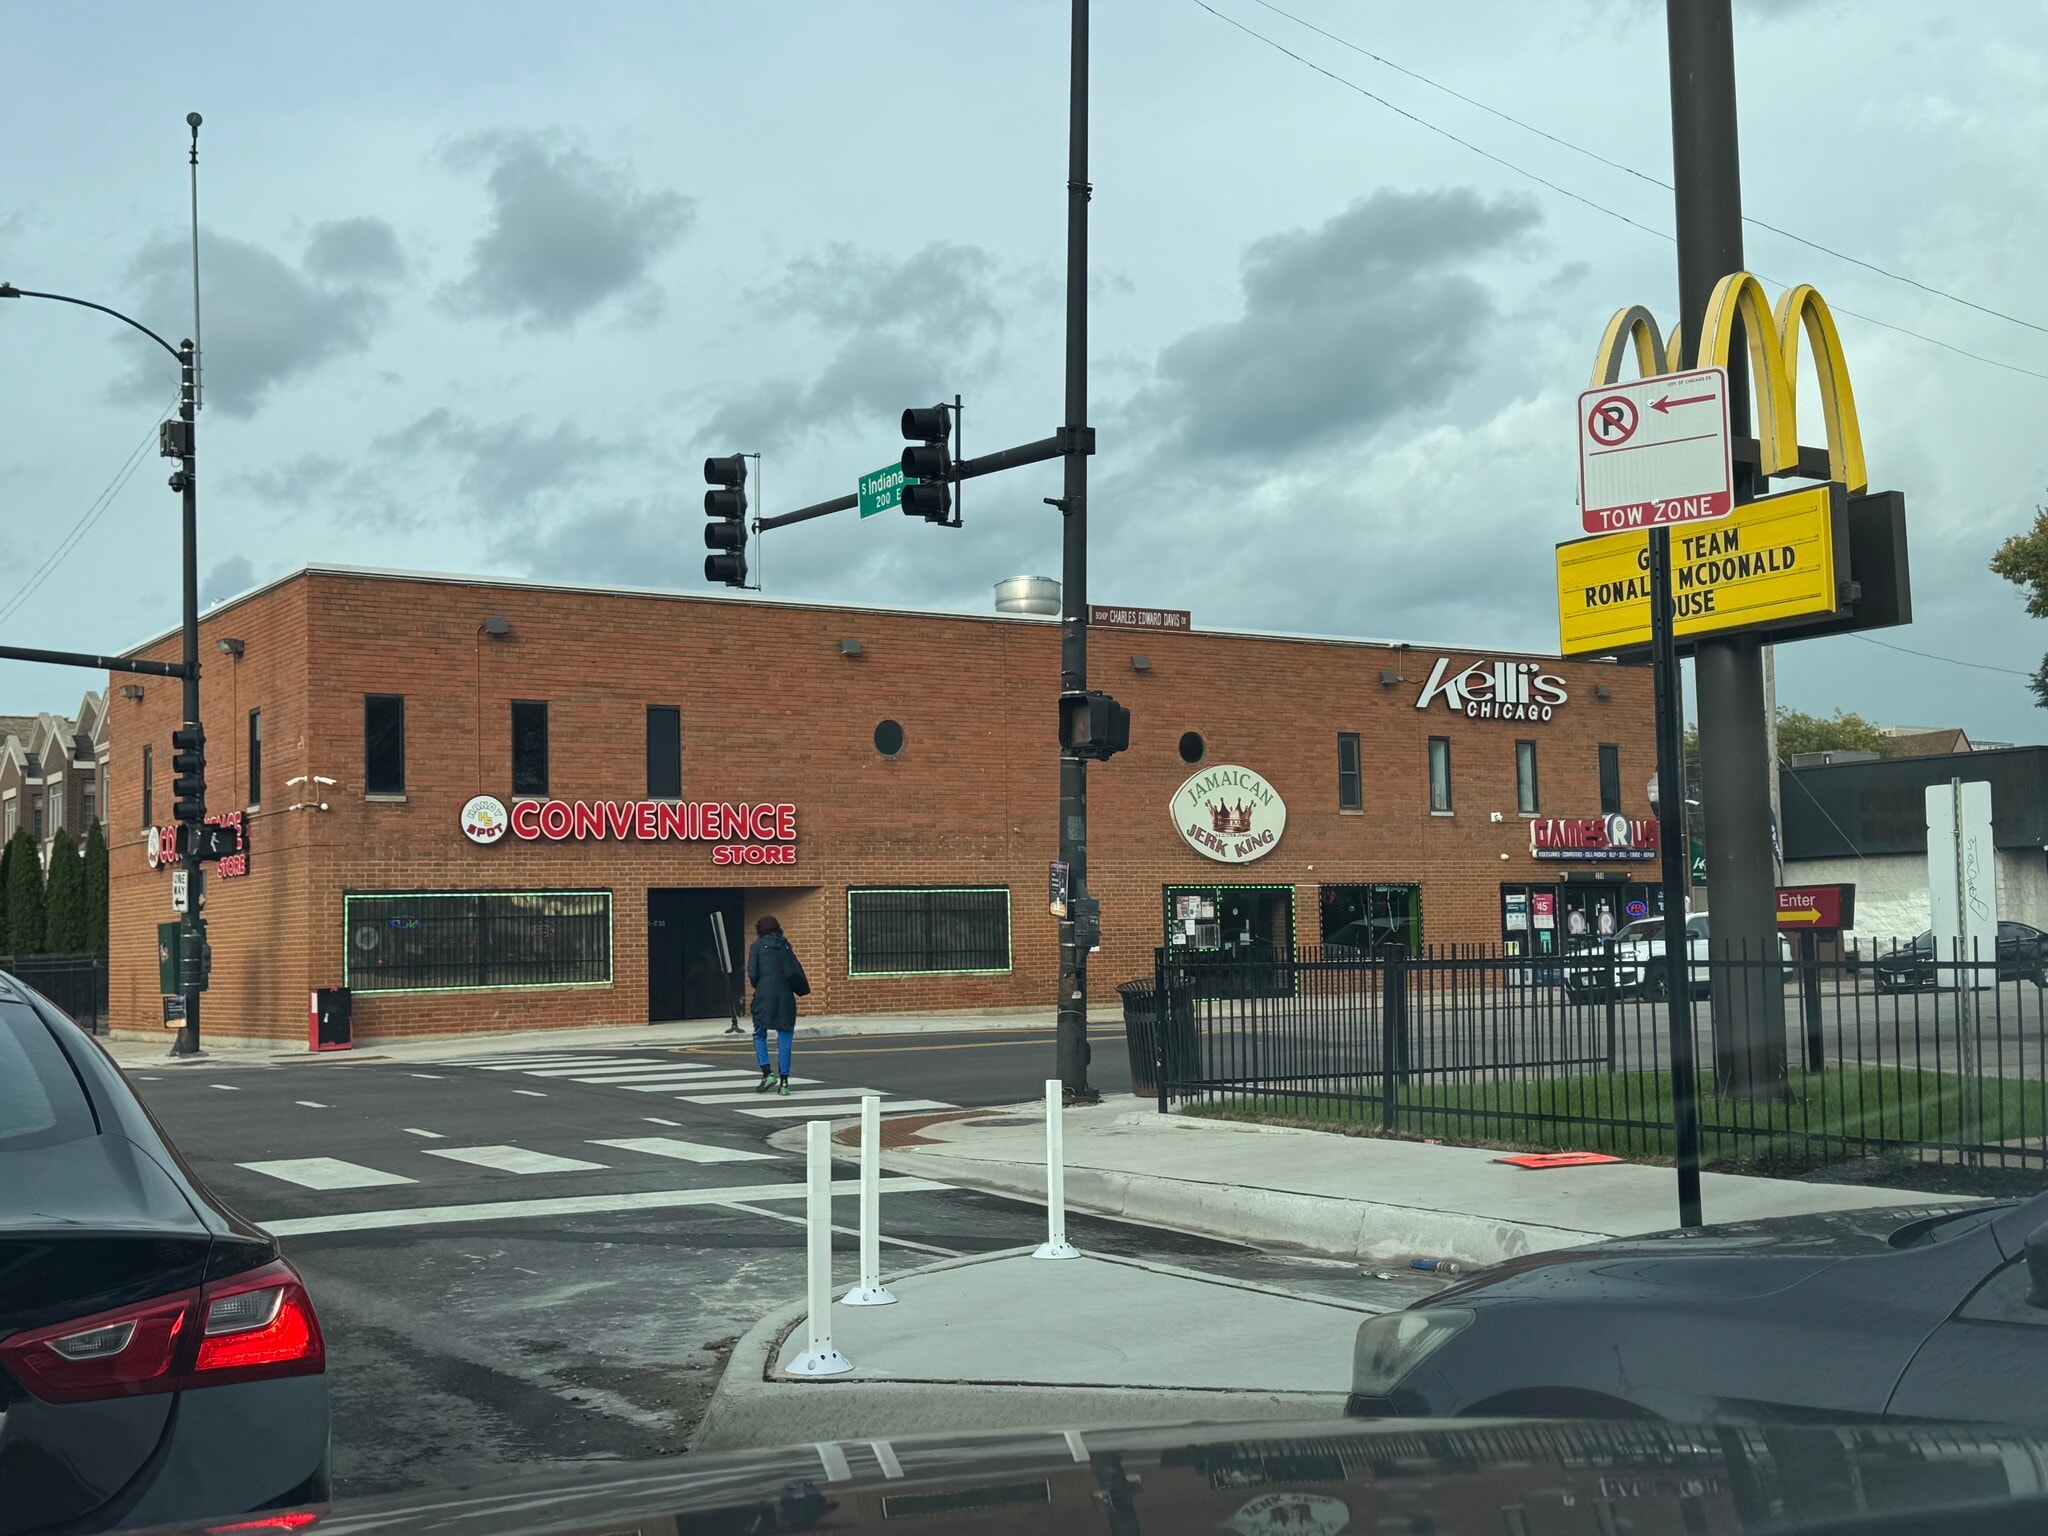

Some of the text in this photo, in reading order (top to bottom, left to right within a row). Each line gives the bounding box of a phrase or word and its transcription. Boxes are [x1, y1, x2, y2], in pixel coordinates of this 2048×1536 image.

[862, 471, 904, 495] S Indiana
[876, 492, 891, 508] 200
[1600, 496, 1713, 529] TOW ZONE
[1682, 528, 1740, 561] TEAM
[1585, 546, 1796, 608] RONAL MCDONALD
[1109, 609, 1136, 625] CHARLES
[1138, 611, 1162, 626] EDWARD
[1163, 612, 1180, 627] DAVIS
[1415, 657, 1568, 710] Kelli's
[1466, 701, 1552, 721] CHICAGO
[1187, 770, 1274, 808] JAMAICAN
[466, 800, 504, 820] HANDY
[511, 800, 797, 841] CONVENIENCE
[466, 823, 504, 838] SPOT
[1186, 823, 1275, 858] JERK KING
[1529, 819, 1607, 848] GAMES
[1631, 820, 1659, 848] US
[217, 853, 245, 878] STORE
[712, 845, 797, 865] STORE
[174, 873, 186, 884] ONE
[174, 885, 185, 896] WAY
[1779, 893, 1816, 907] Enter
